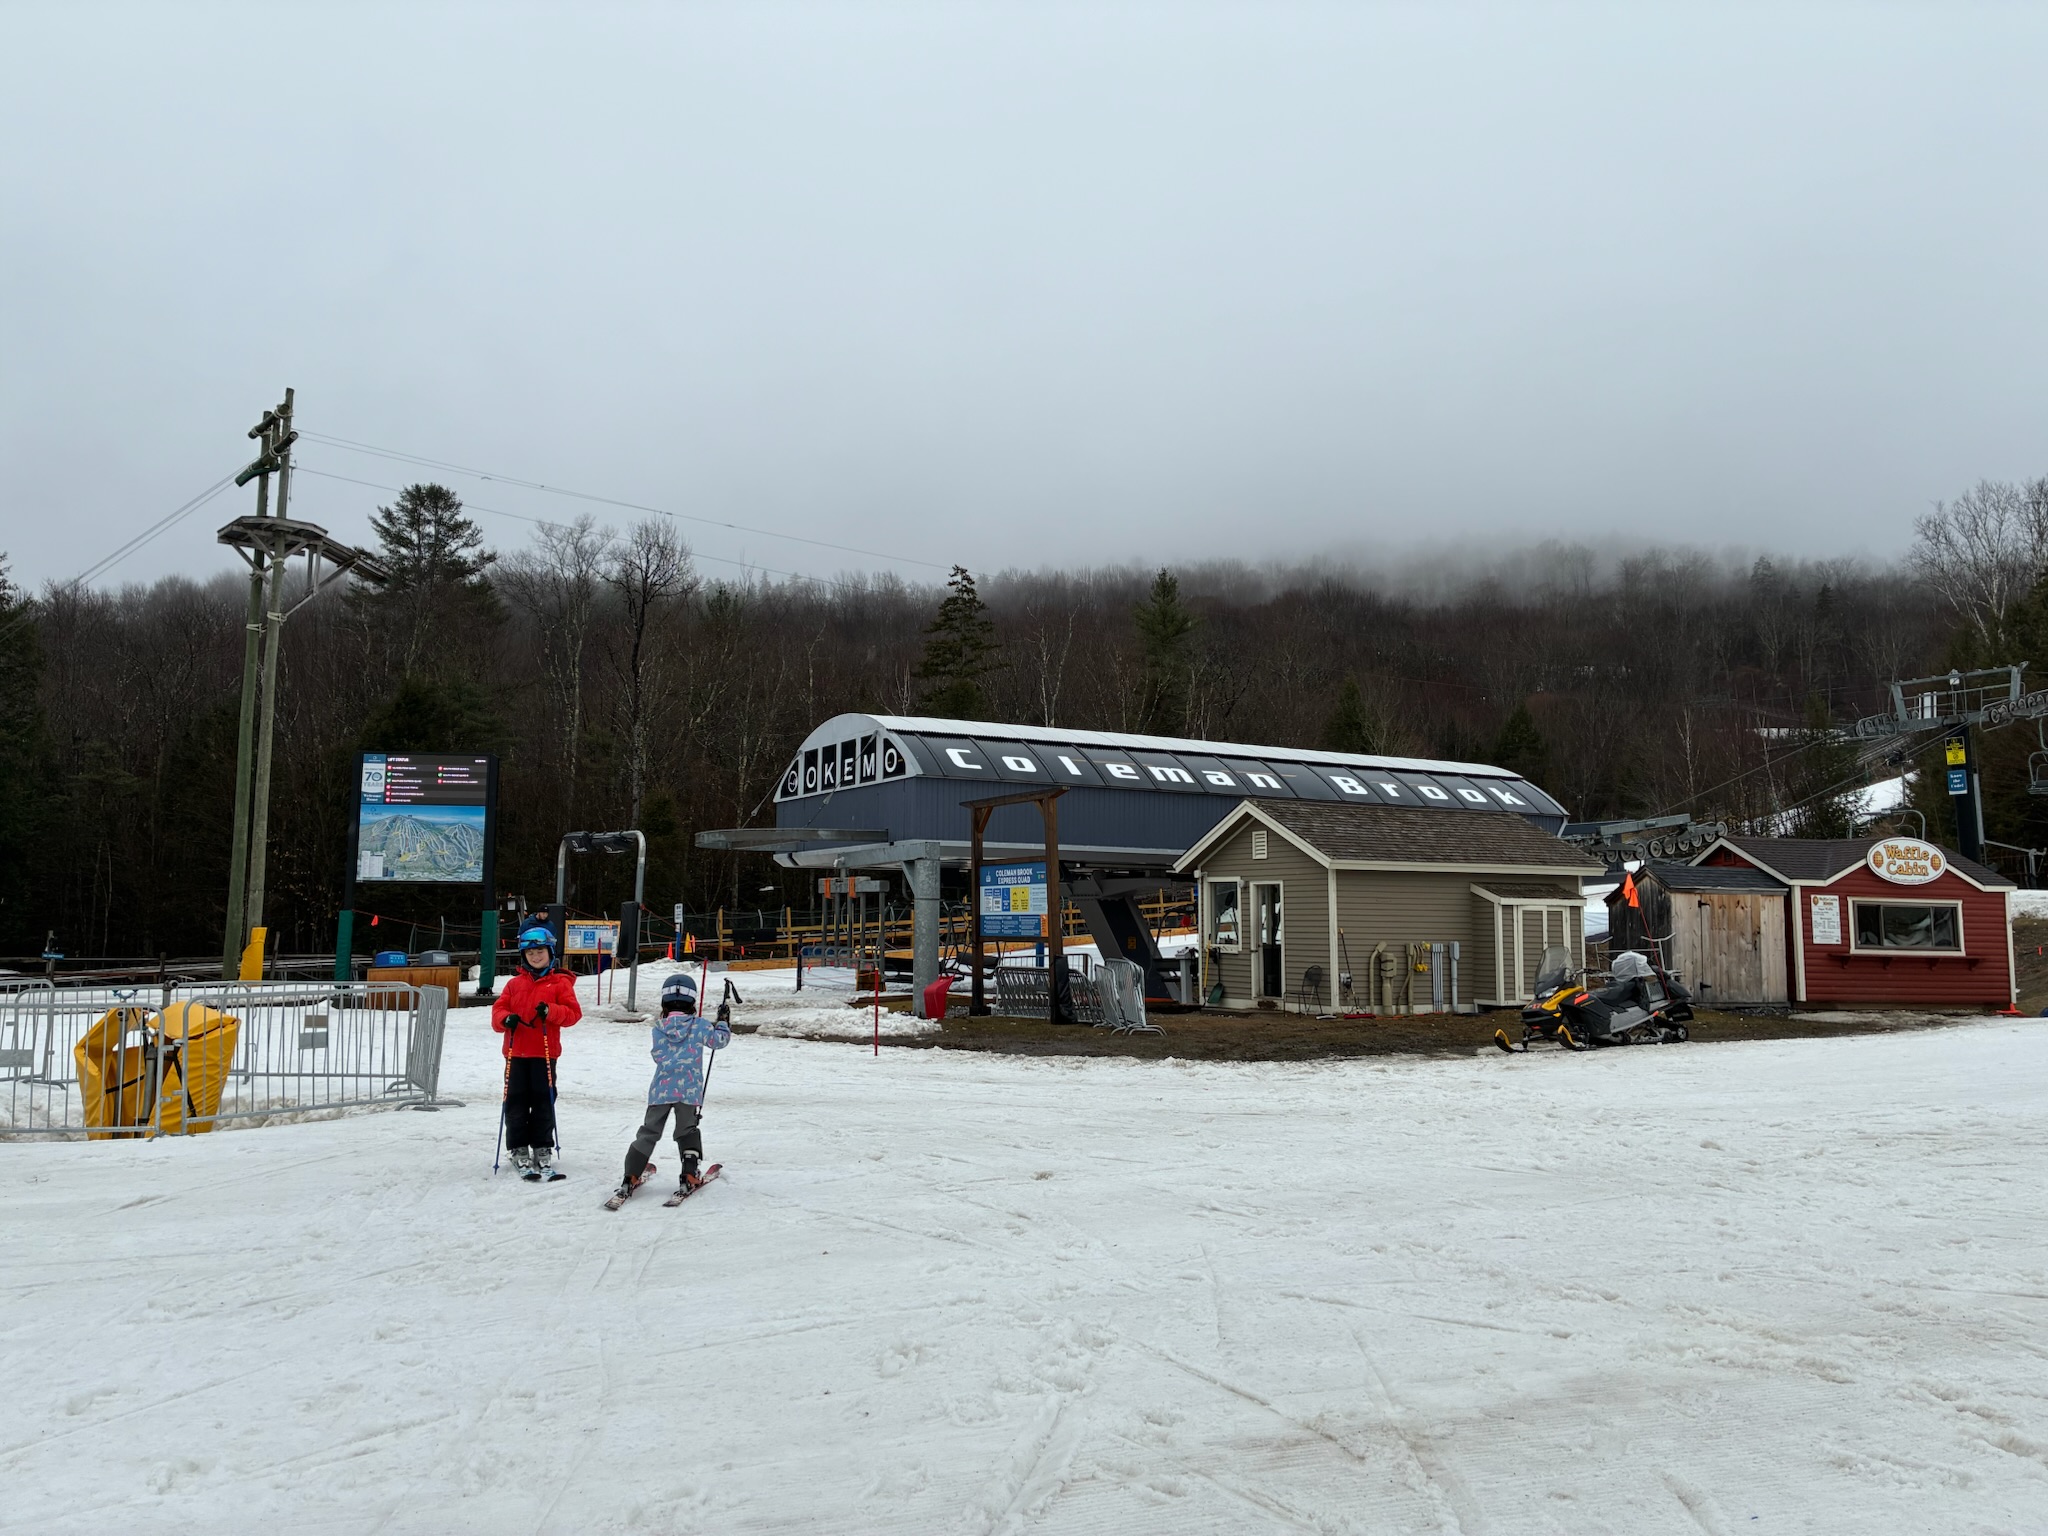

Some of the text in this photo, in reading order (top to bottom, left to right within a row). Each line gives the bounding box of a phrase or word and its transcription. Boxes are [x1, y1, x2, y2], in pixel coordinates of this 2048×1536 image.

[365, 771, 382, 781] 70
[806, 748, 897, 789] OKEMO
[945, 748, 1526, 805] Coleman Brook
[1883, 844, 1929, 861] Waffle
[995, 869, 1016, 877] COLEMAN
[1017, 868, 1033, 876] BROOK
[1886, 860, 1928, 876] Cabin
[998, 876, 1017, 884] EXPRESS
